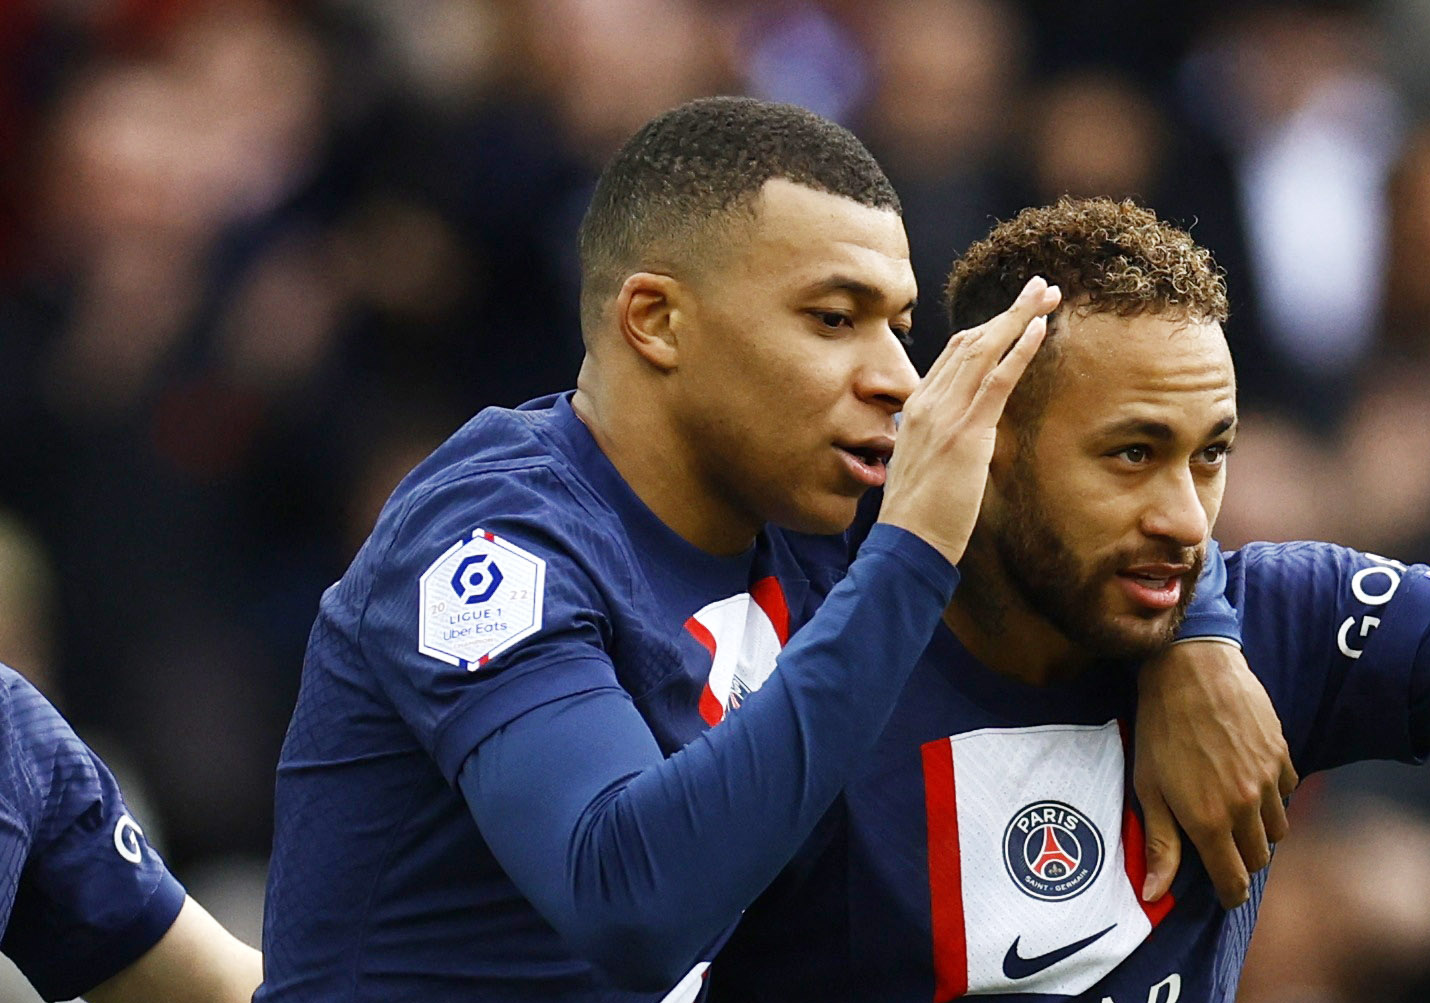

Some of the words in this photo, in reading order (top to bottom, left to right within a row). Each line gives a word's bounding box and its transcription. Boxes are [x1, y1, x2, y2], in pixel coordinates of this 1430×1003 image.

[449, 608, 491, 625] LIGUE
[1337, 552, 1408, 660] GO
[443, 627, 472, 641] Uber
[475, 621, 508, 634] Eats
[1016, 807, 1079, 834] PARIS
